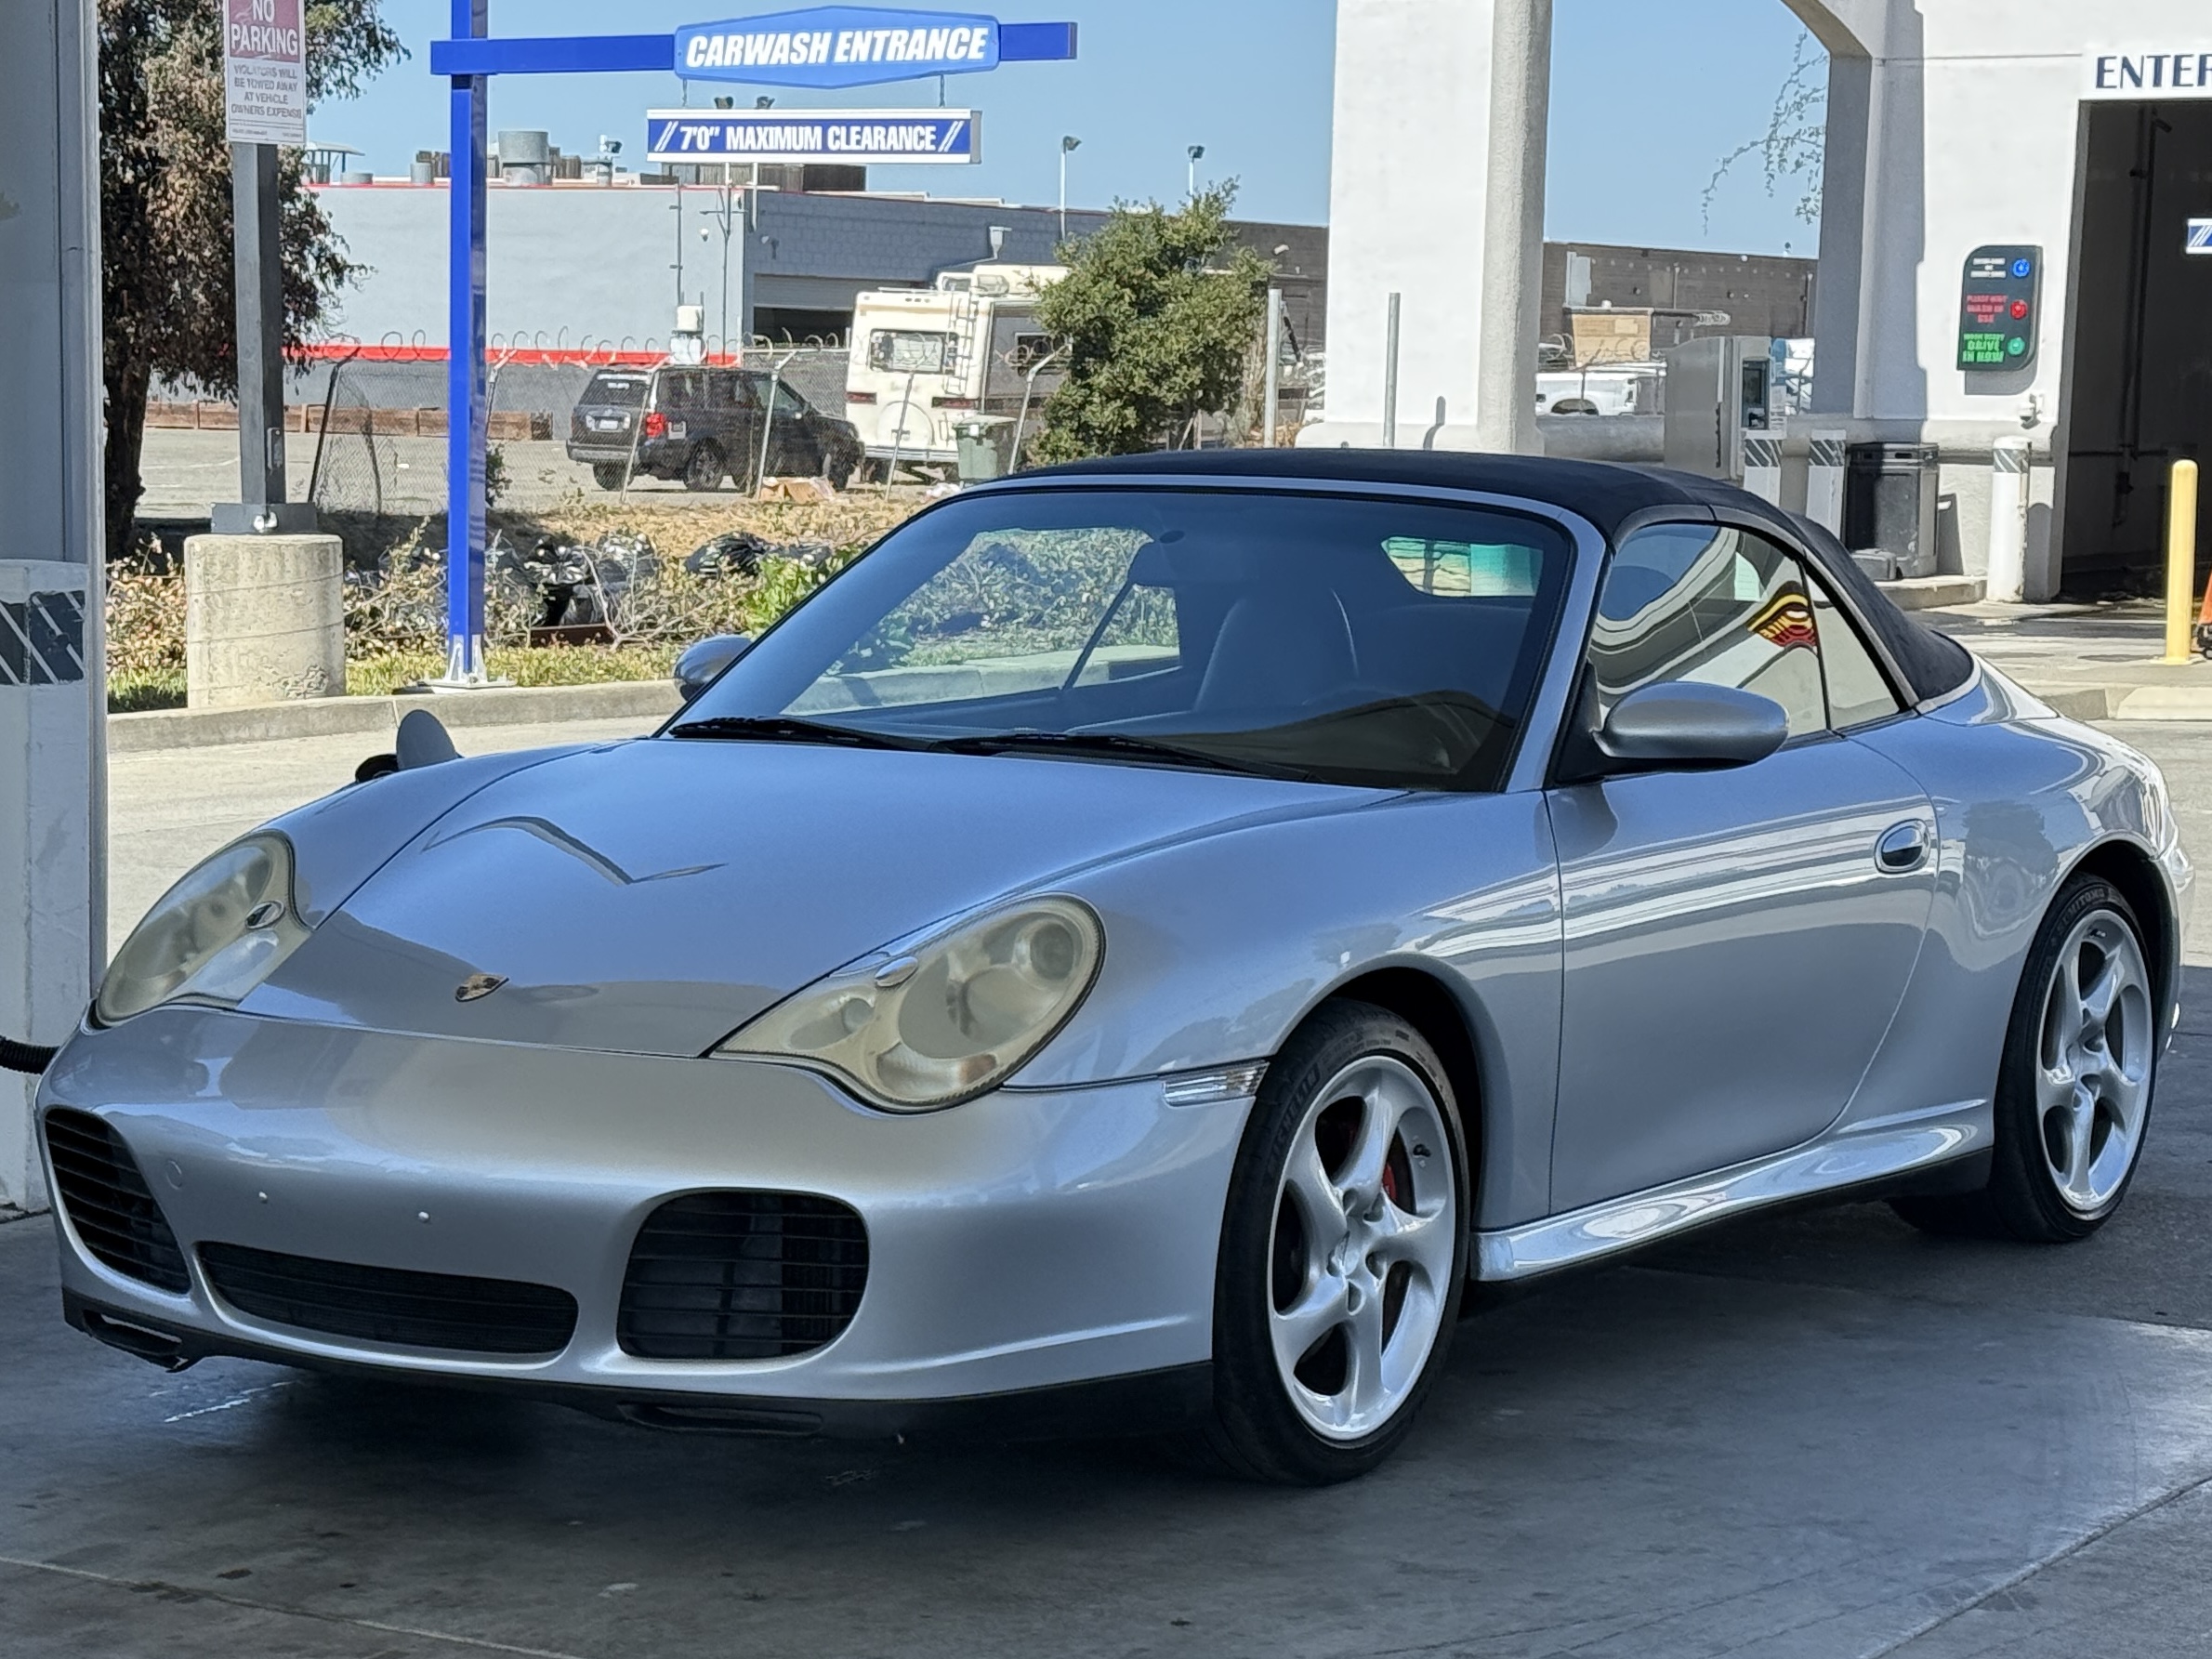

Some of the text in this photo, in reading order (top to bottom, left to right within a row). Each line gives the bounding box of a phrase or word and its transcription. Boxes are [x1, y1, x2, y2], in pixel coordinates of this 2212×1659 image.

[253, 0, 275, 22] NO
[230, 23, 297, 56] PARKING
[685, 27, 989, 69] CARWASH ENTRANCE
[233, 64, 297, 79] VIOLATORS WILL
[234, 77, 298, 92] BE TOWED AWAY
[244, 91, 289, 105] AT VEHICLE
[230, 104, 265, 116] OWNERS
[679, 125, 937, 151] 7'0" MAXIMUM CLEARANCE
